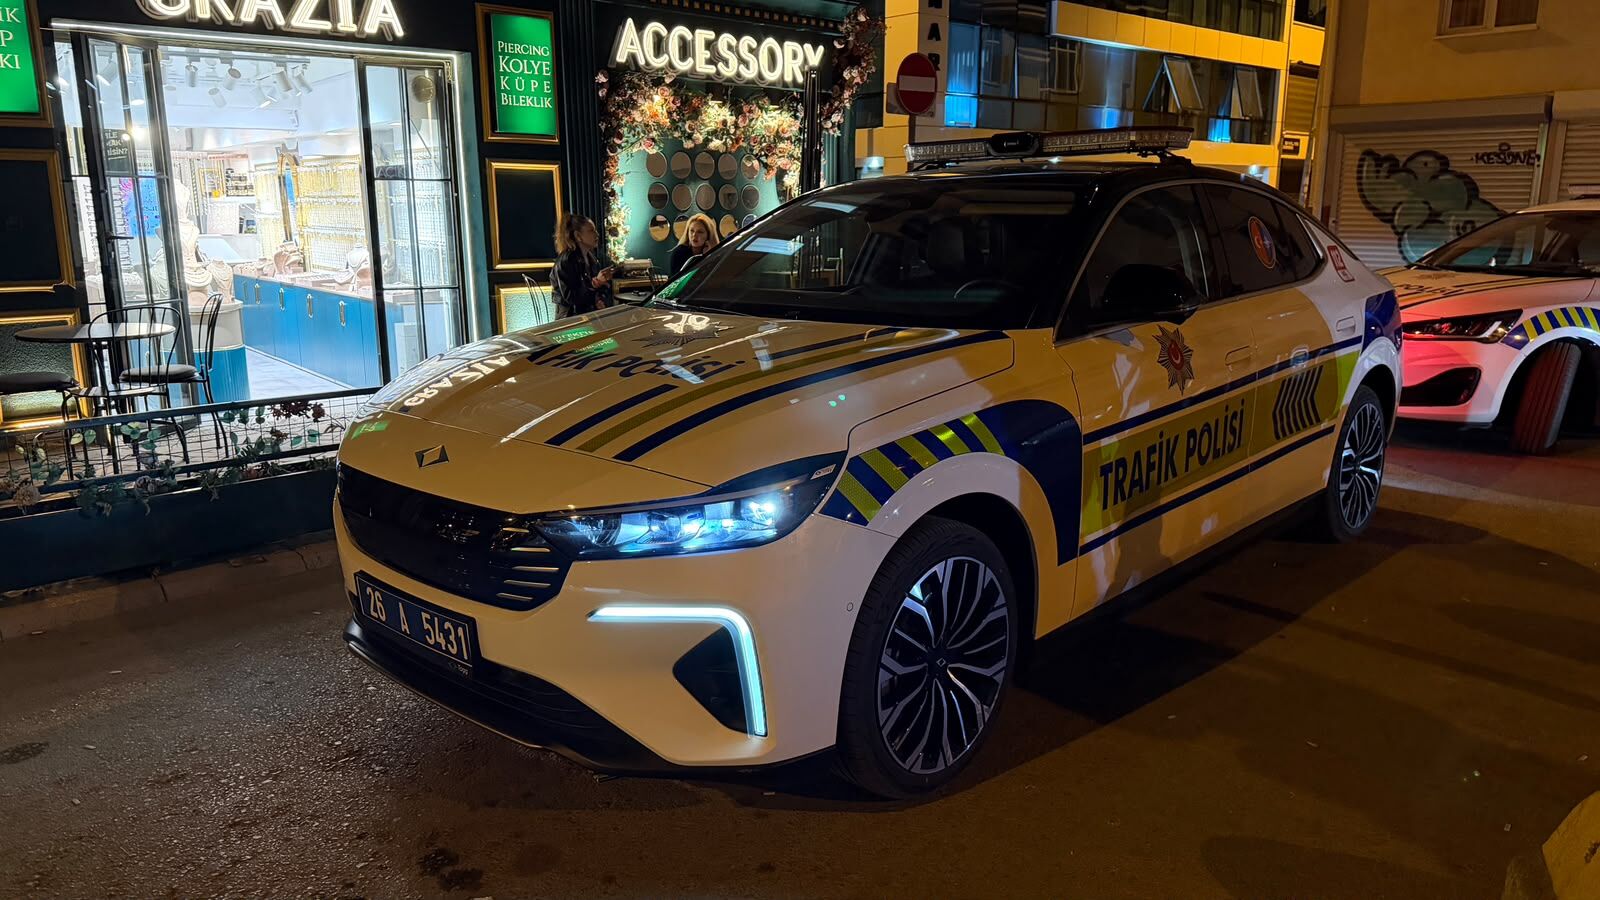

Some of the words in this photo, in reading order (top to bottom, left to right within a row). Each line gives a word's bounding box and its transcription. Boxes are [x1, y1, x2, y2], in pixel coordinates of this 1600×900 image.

[499, 55, 552, 76] KOLYE
[615, 17, 825, 83] ACCESSORY
[1100, 430, 1180, 512] TRAFİK
[1184, 398, 1245, 473] POLİSİ
[366, 586, 386, 622] 26
[398, 602, 410, 635] A
[421, 611, 468, 660] 5431
